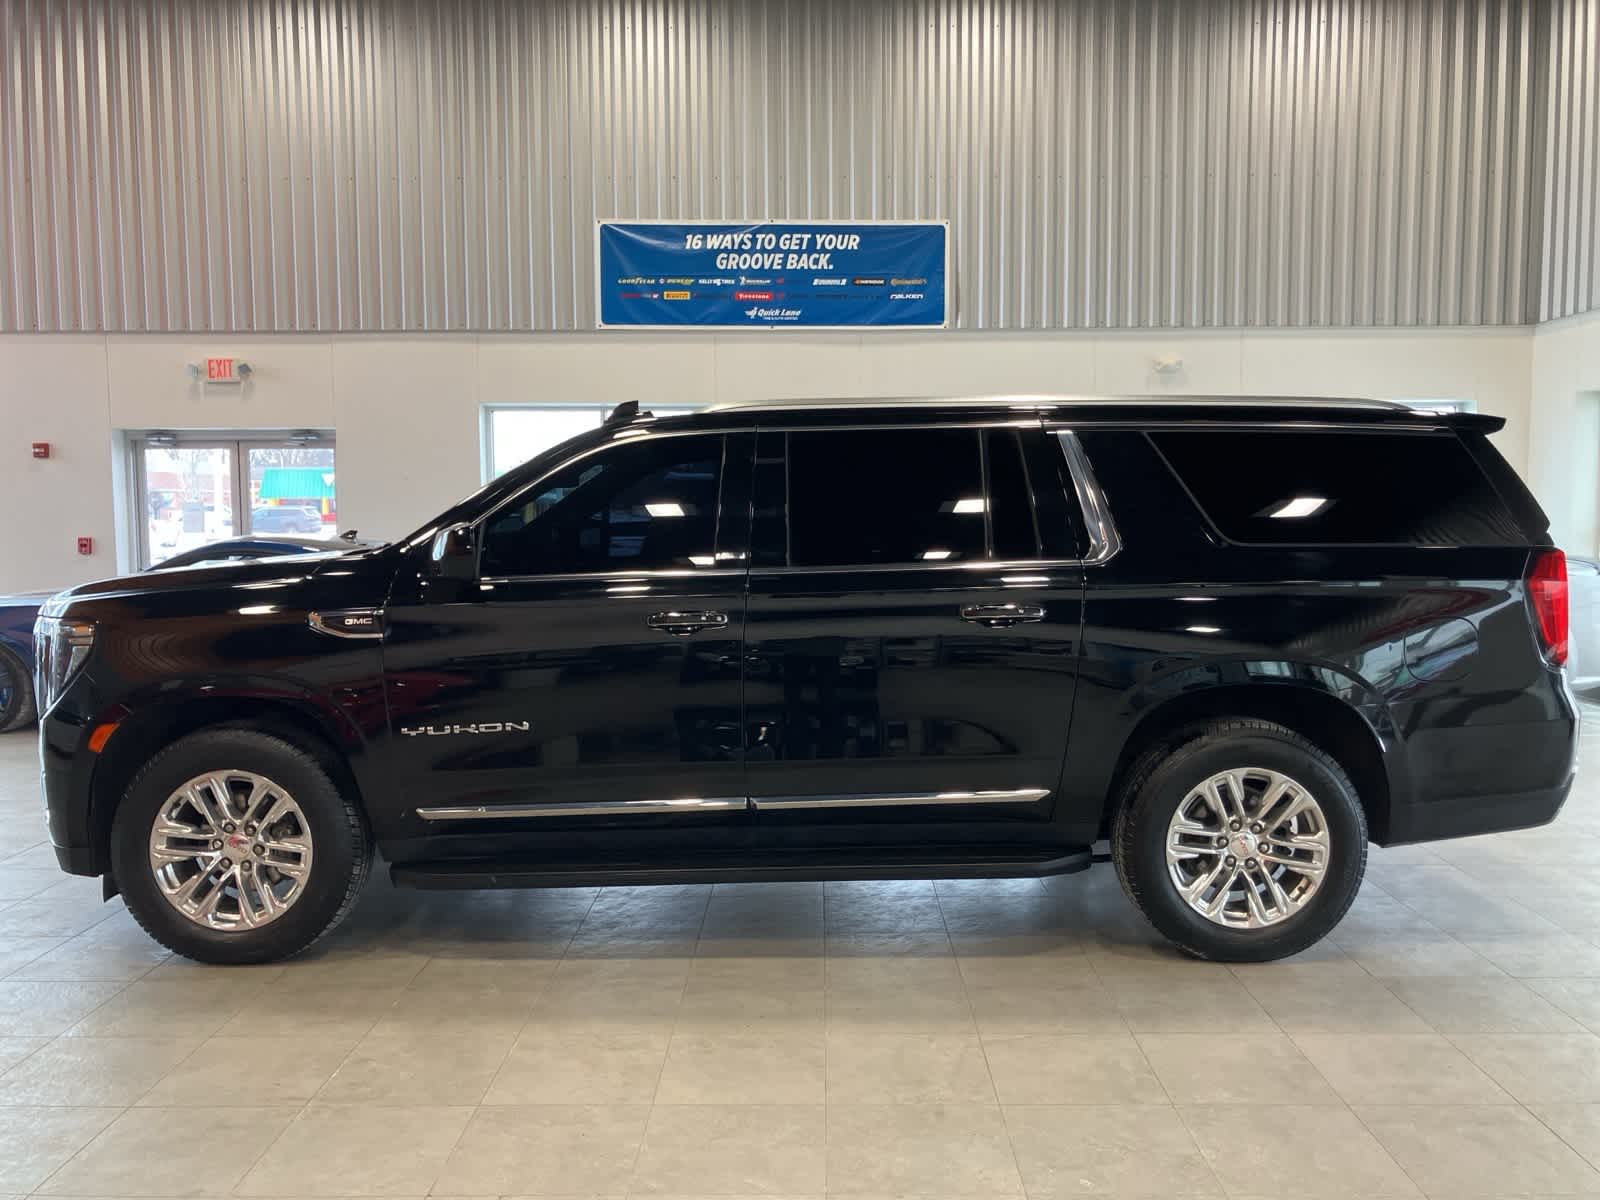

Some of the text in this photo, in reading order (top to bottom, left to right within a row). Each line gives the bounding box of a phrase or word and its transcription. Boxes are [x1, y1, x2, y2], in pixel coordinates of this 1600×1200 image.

[685, 233, 860, 250] 16 WAYS TO GET YOUR
[716, 253, 834, 270] GROOVE BACK.
[757, 308, 802, 317] Quick Lane
[207, 359, 233, 379] EXIT
[344, 617, 373, 625] GMC
[401, 721, 529, 736] YUKON
